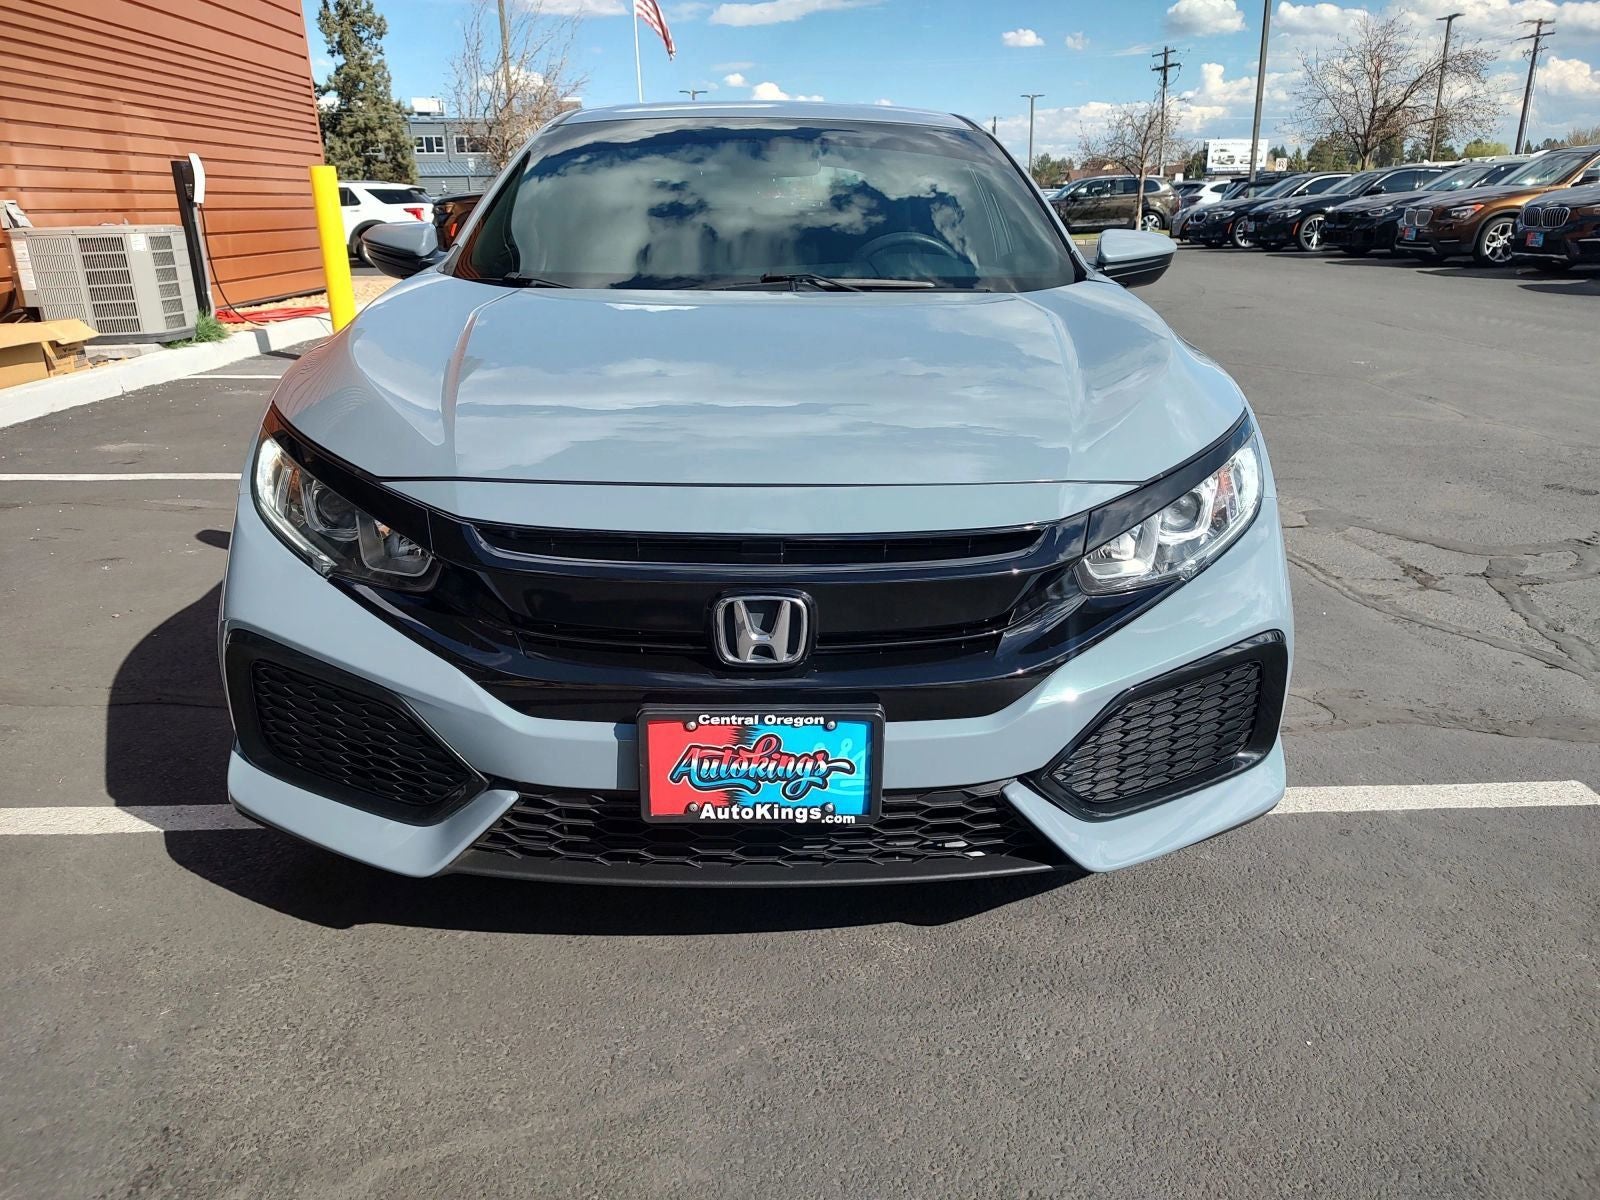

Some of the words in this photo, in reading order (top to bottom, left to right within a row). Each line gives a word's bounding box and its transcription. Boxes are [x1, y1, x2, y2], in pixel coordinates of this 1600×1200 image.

[698, 714, 759, 726] Central
[764, 714, 825, 728] Oregon
[700, 803, 856, 824] AutoKings.com
